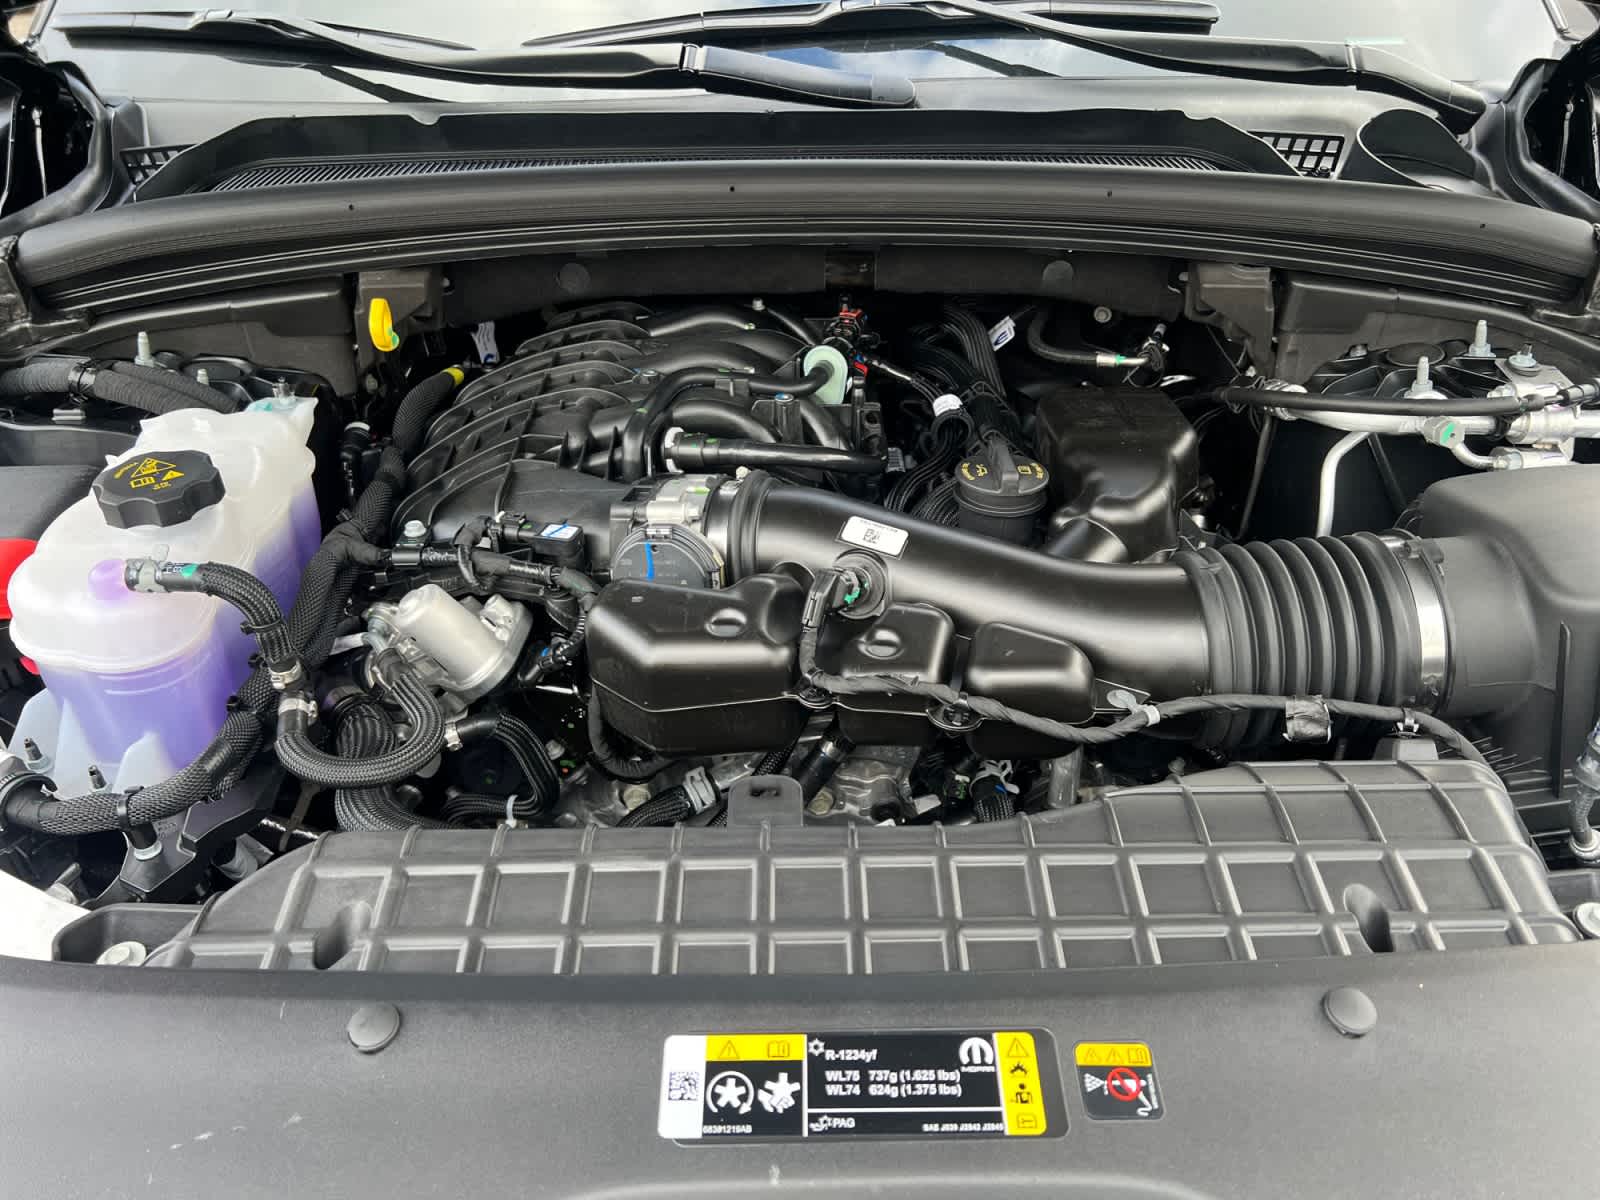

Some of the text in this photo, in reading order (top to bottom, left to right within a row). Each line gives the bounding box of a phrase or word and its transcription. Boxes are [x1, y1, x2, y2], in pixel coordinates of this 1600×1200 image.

[825, 1049, 878, 1063] R-1234yf
[825, 1069, 961, 1084] WL75 737g (1.625 lbs)
[825, 1083, 962, 1098] WL74 624g (1.375 lbs)
[832, 1117, 856, 1128] PAG
